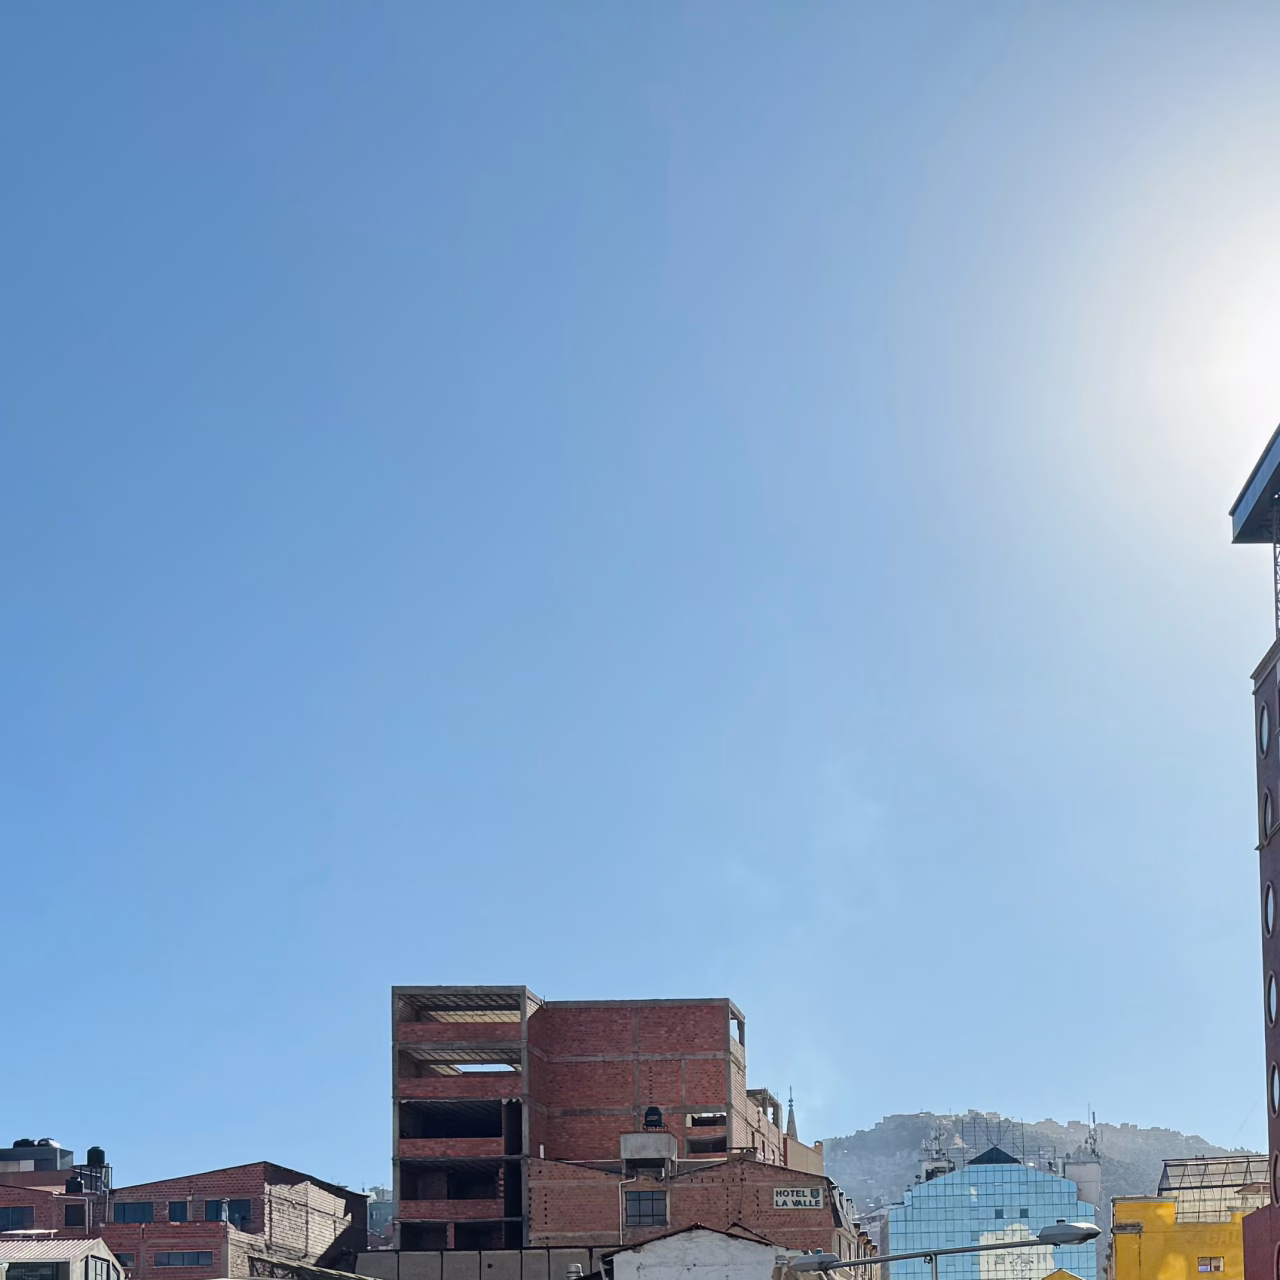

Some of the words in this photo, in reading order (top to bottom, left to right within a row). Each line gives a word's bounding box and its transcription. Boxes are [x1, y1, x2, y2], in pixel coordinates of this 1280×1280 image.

[775, 1189, 808, 1198] HOTEL
[775, 1199, 789, 1207] LA
[791, 1199, 821, 1207] VALLE
